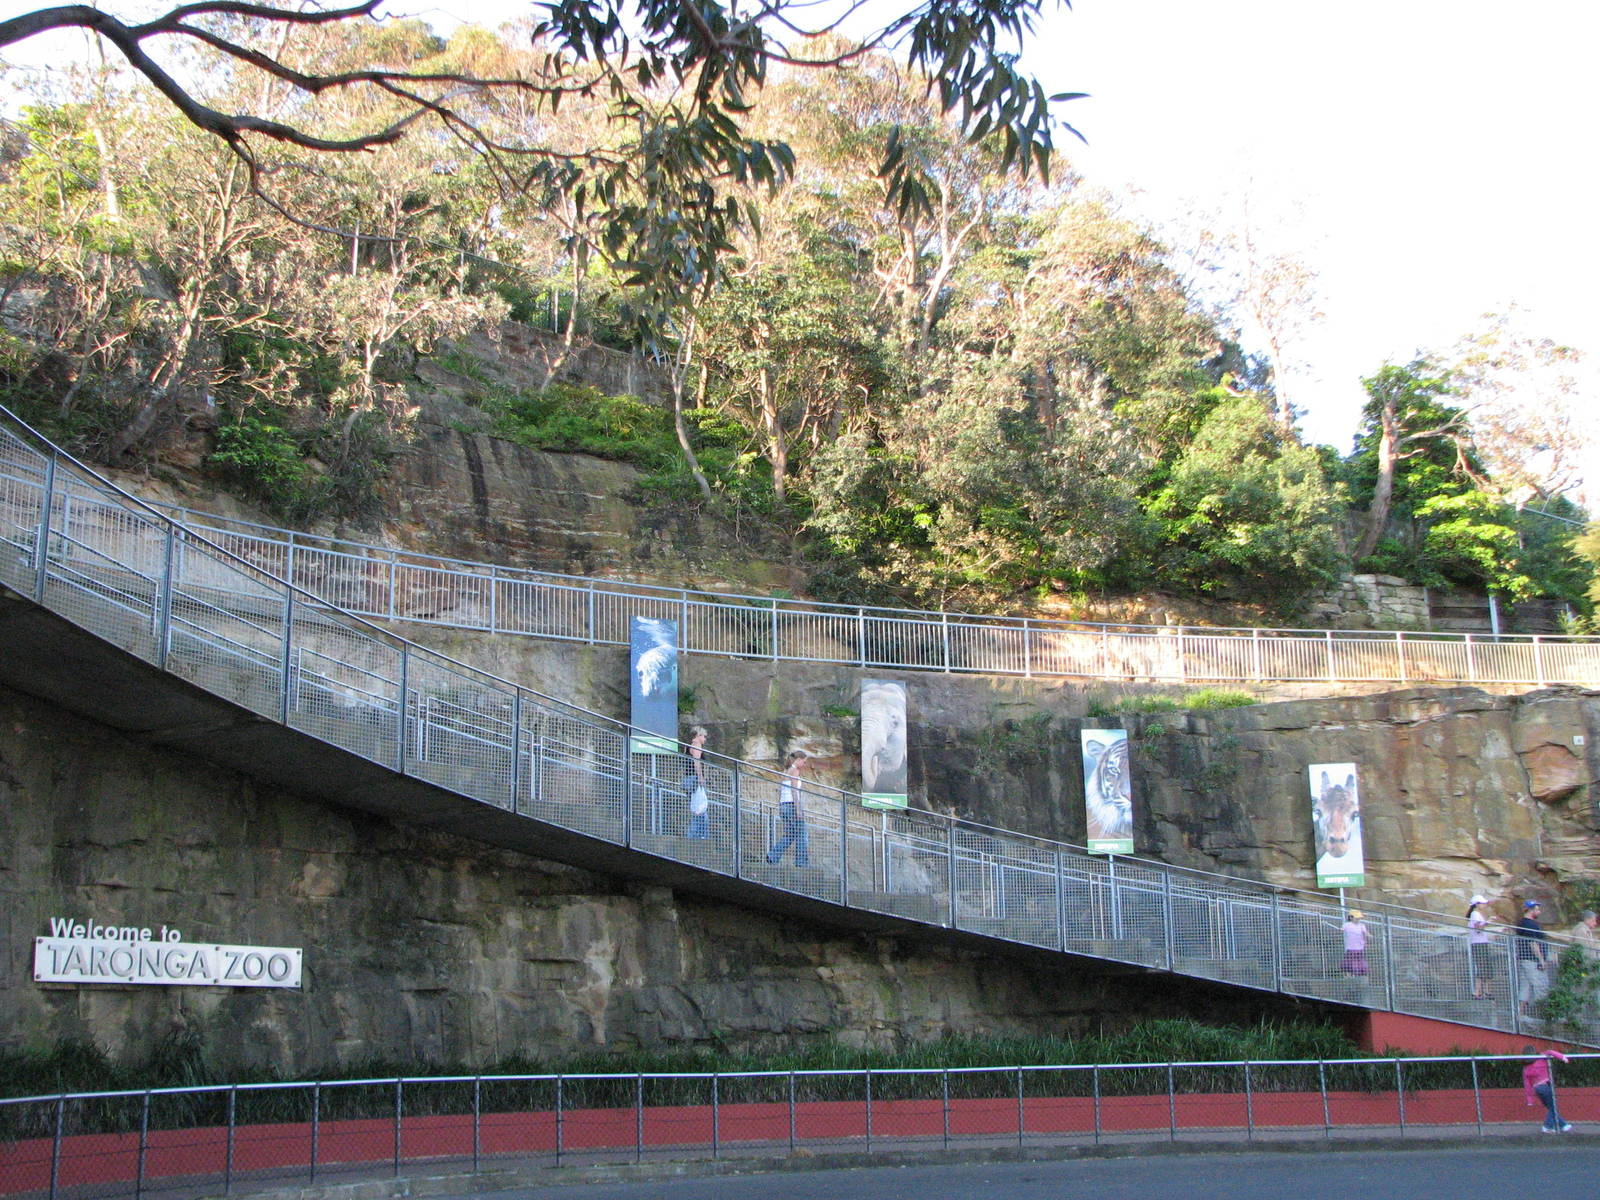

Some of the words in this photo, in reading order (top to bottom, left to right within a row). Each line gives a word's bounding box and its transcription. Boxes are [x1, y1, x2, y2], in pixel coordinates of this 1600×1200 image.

[50, 916, 152, 941] Welcome
[161, 925, 181, 943] to
[48, 945, 211, 978] TARONGA
[224, 951, 292, 982] ZOO
